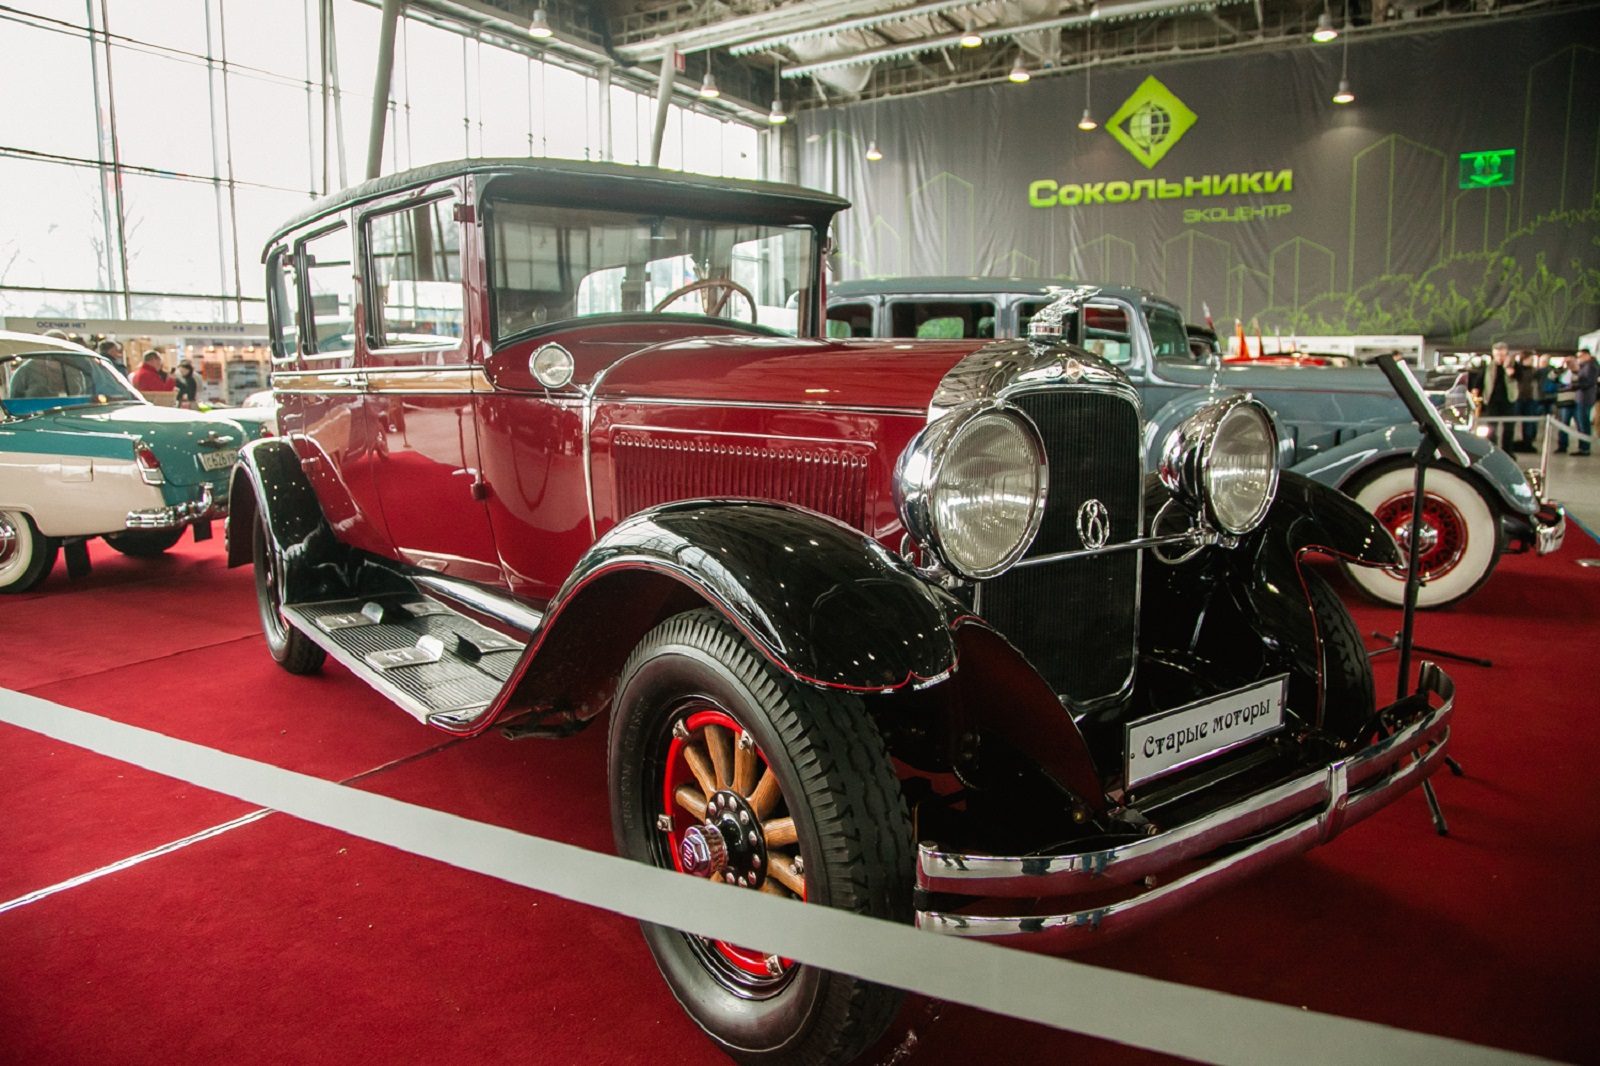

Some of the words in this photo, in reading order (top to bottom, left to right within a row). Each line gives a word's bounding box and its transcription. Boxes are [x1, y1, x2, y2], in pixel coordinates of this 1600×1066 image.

[1029, 169, 1293, 208] Сокольники
[1183, 204, 1292, 223] ЭКОЦЕНТР
[1143, 721, 1208, 758] Старые
[1212, 699, 1270, 733] моторы
